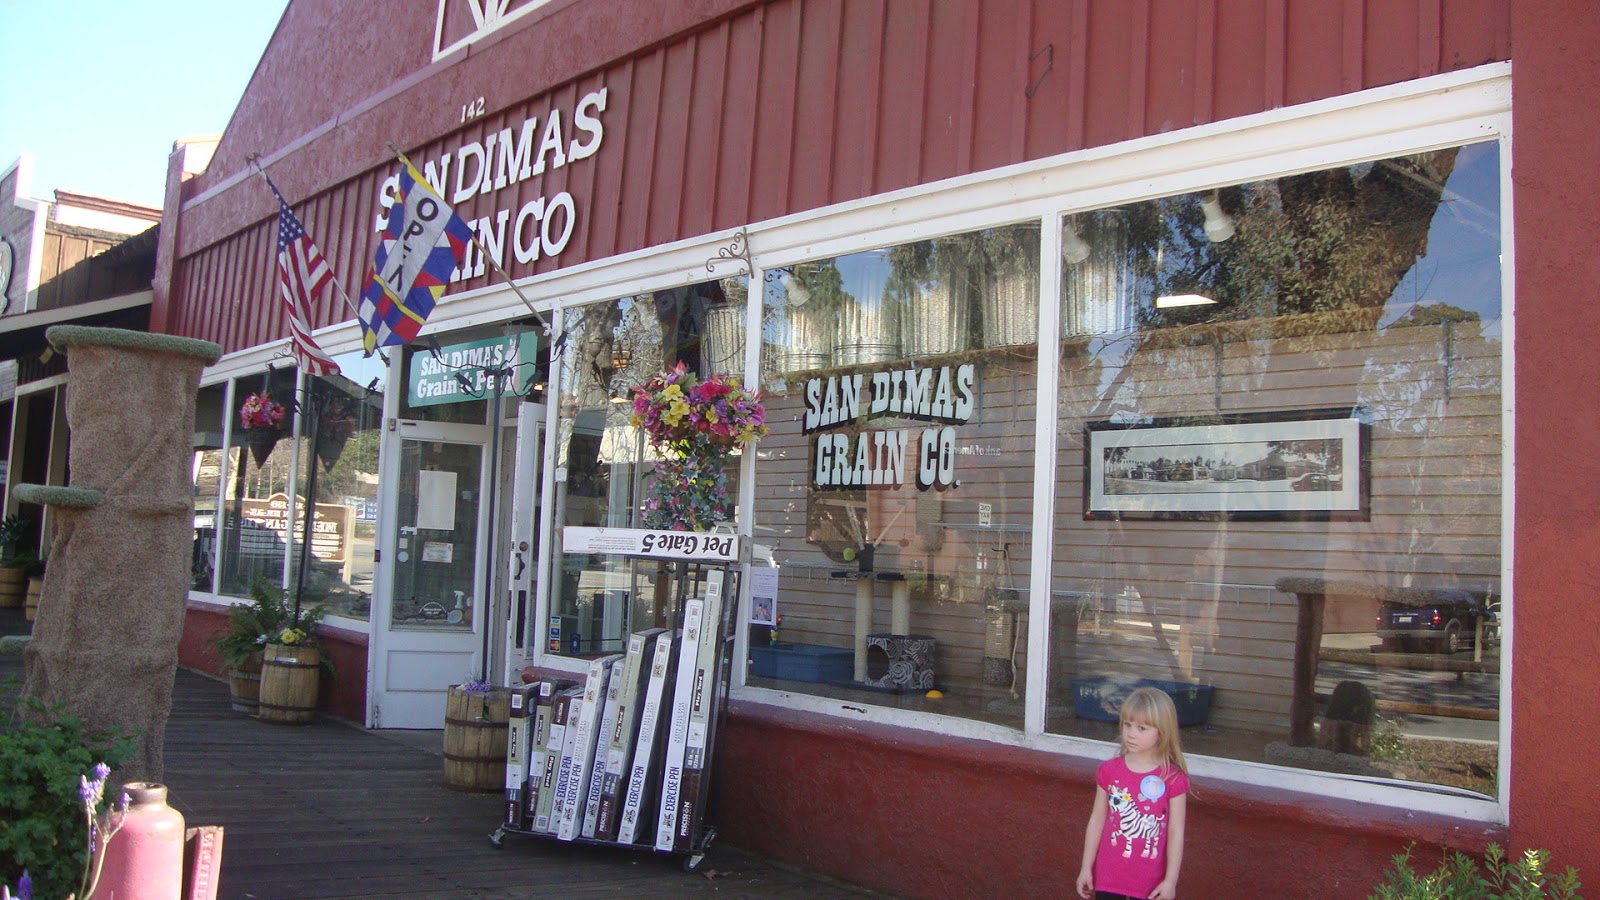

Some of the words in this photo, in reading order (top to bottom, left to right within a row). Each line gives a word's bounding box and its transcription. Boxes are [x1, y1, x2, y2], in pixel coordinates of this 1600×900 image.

[460, 97, 486, 123] 142
[375, 152, 451, 233] SN
[453, 87, 607, 204] DIMAS
[513, 191, 576, 265] CO
[420, 352, 449, 377] SAN
[417, 375, 457, 399] Grain
[805, 374, 863, 430] SAN
[870, 364, 975, 421] DIMAS
[815, 429, 909, 487] GRAIN
[919, 427, 961, 487] CO.
[640, 533, 656, 554] 5
[656, 534, 699, 555] Gate
[701, 536, 734, 557] Pet
[557, 768, 570, 798] EXERCISE
[564, 756, 572, 769] PEN
[573, 764, 582, 778] PEN
[596, 760, 606, 773] PEN
[668, 766, 680, 780] PEN
[567, 778, 580, 806] EXERCISE
[590, 772, 603, 802] EXERCISE
[627, 781, 641, 808] EXERCISE
[634, 765, 645, 781] PEN
[664, 780, 678, 812] EXERCISE
[680, 801, 691, 837] PRECISION
